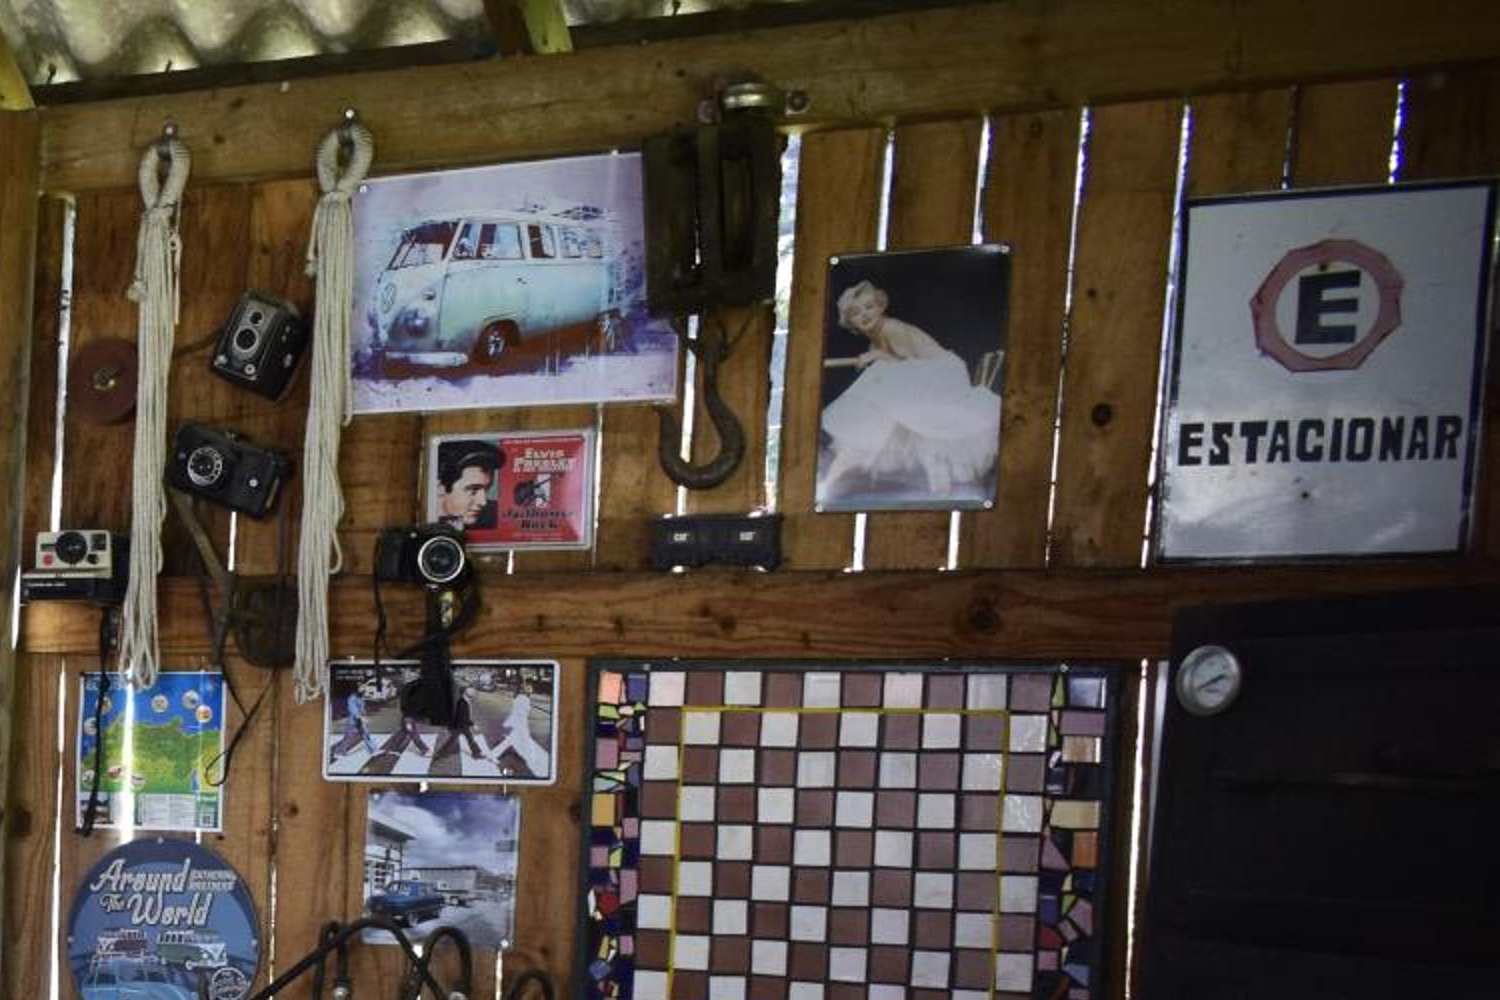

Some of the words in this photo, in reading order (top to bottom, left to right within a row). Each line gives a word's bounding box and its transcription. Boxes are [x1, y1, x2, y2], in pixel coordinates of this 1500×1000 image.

[1295, 270, 1361, 345] E
[1177, 415, 1463, 467] ESTACIONAR
[90, 856, 191, 893] Around
[128, 892, 213, 926] World
